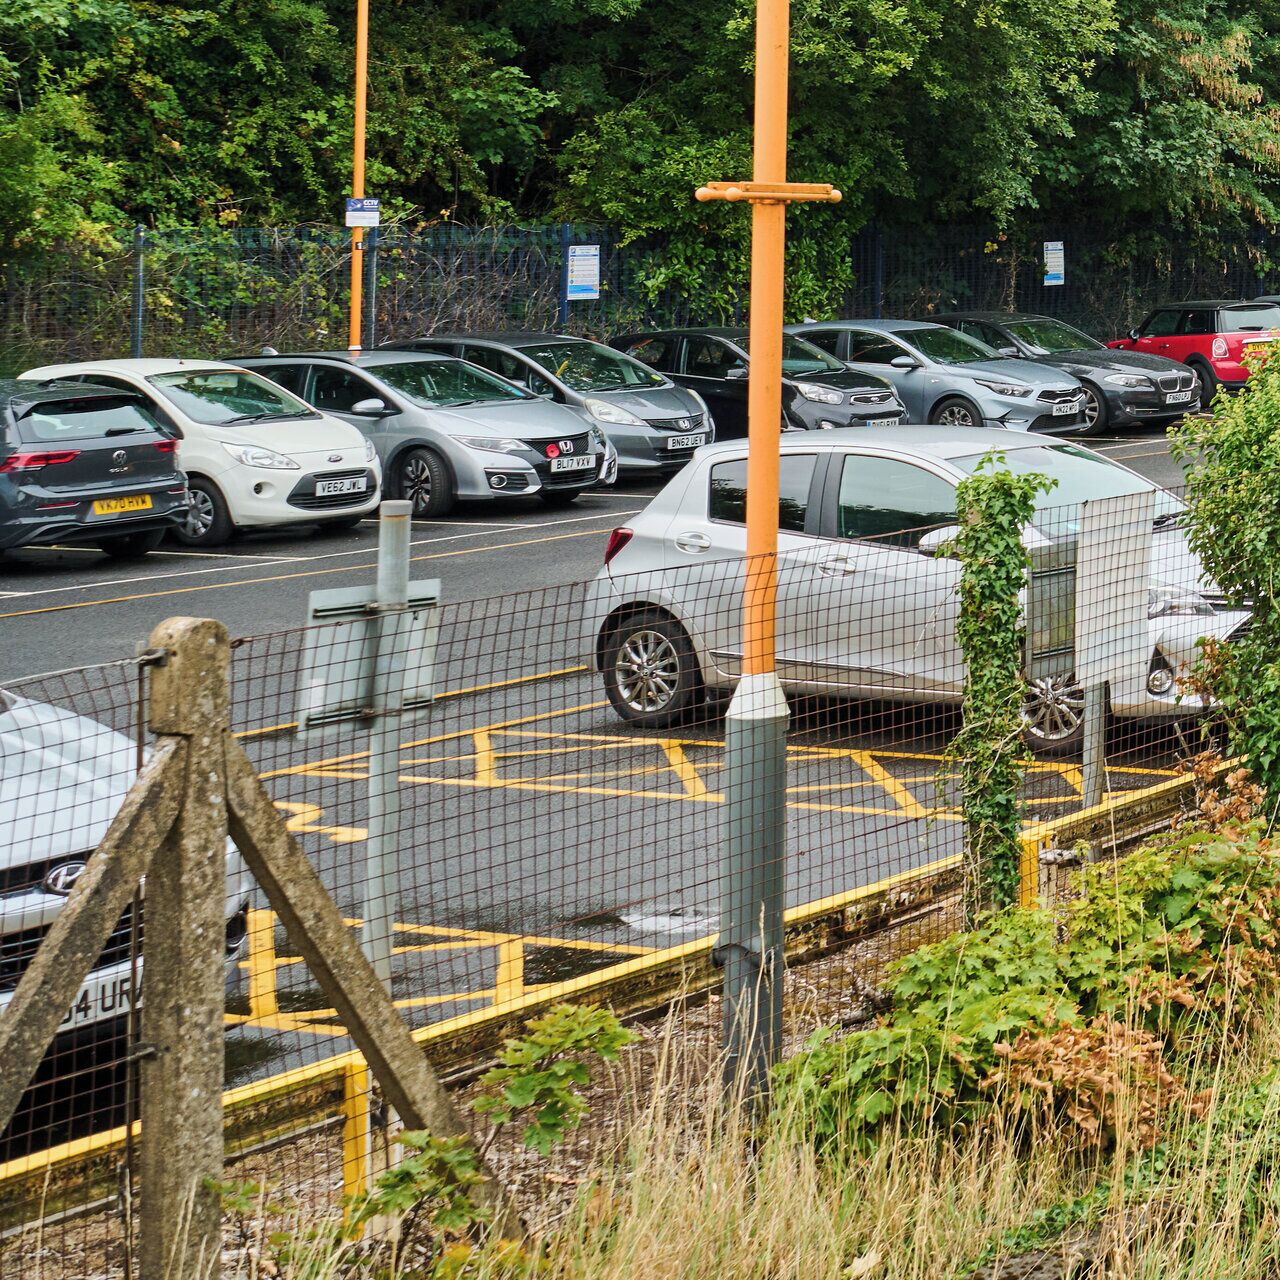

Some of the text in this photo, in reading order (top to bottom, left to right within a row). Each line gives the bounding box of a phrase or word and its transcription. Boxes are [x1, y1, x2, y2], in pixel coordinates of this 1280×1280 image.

[671, 437, 690, 448] BN62
[576, 457, 591, 468] VXV
[321, 481, 345, 493] VE62
[99, 497, 126, 511] VK70
